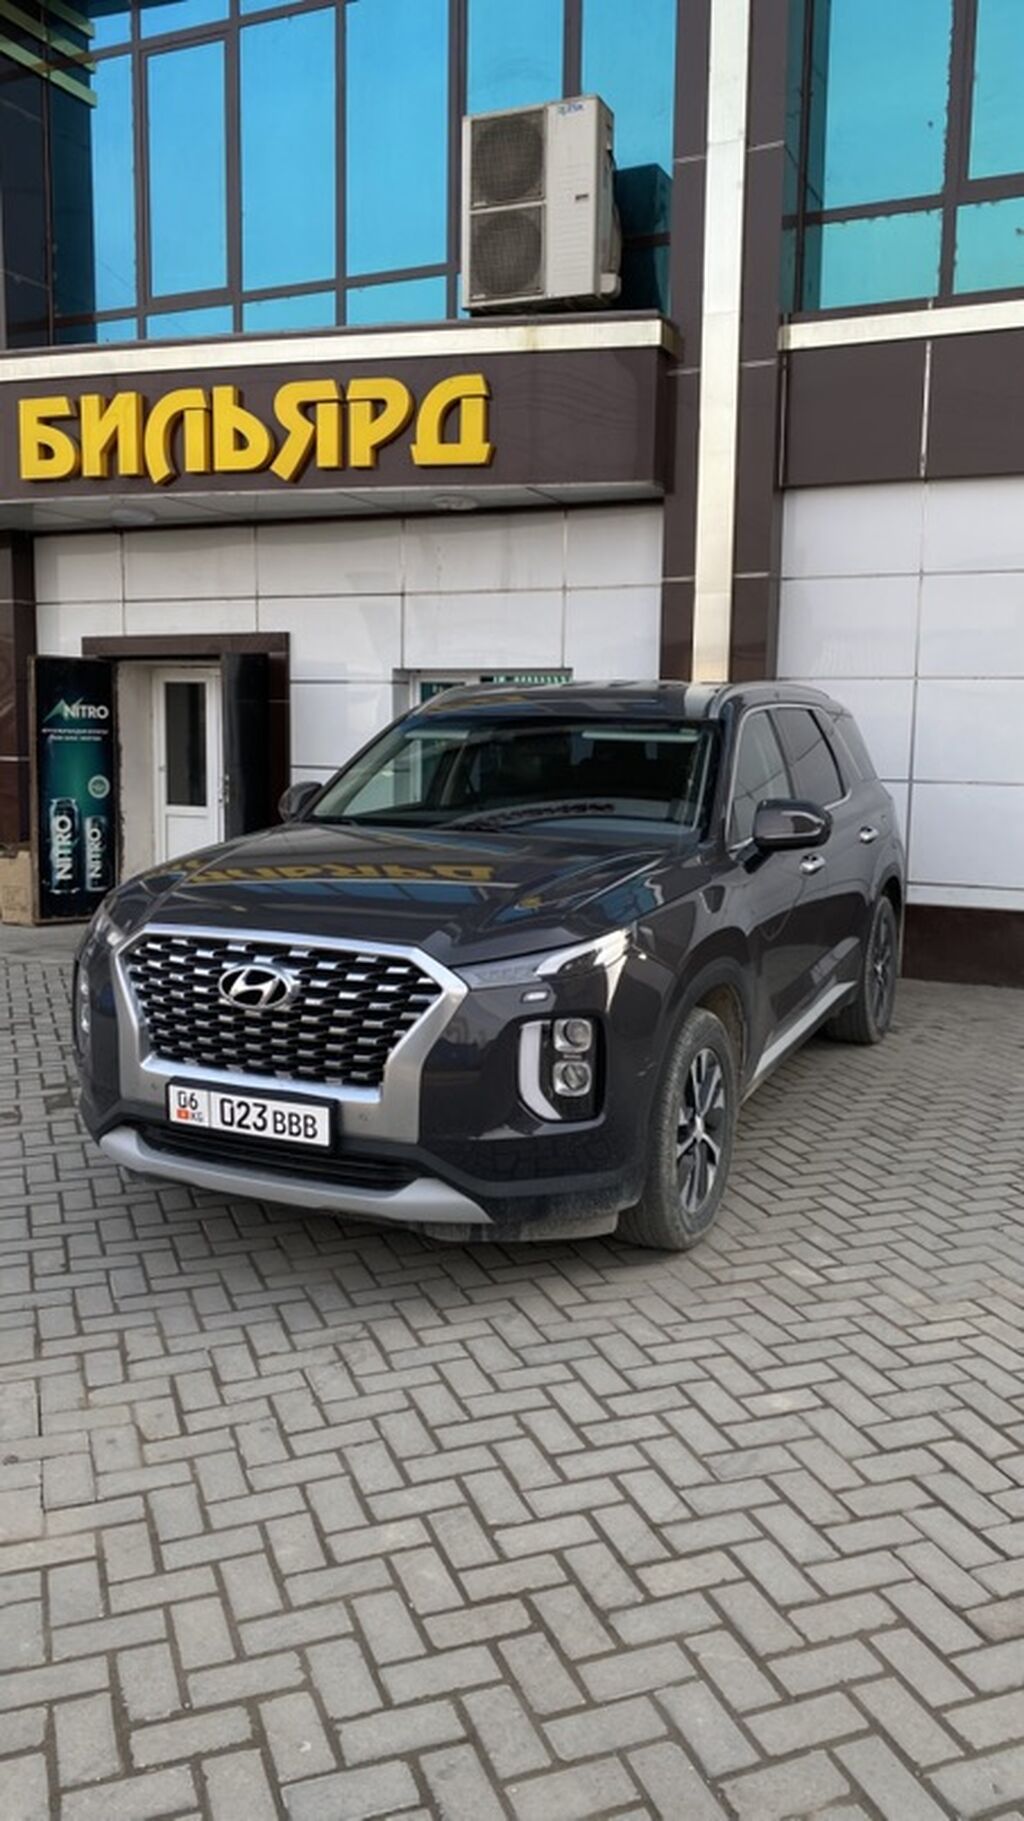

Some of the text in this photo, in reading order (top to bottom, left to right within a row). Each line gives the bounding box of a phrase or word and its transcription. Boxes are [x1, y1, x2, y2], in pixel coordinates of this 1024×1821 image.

[18, 374, 495, 484] БИЛЬЯРД
[61, 701, 110, 721] NITRO
[55, 815, 72, 879] NITRO
[89, 827, 102, 878] NITRO
[177, 1091, 199, 1110] 06
